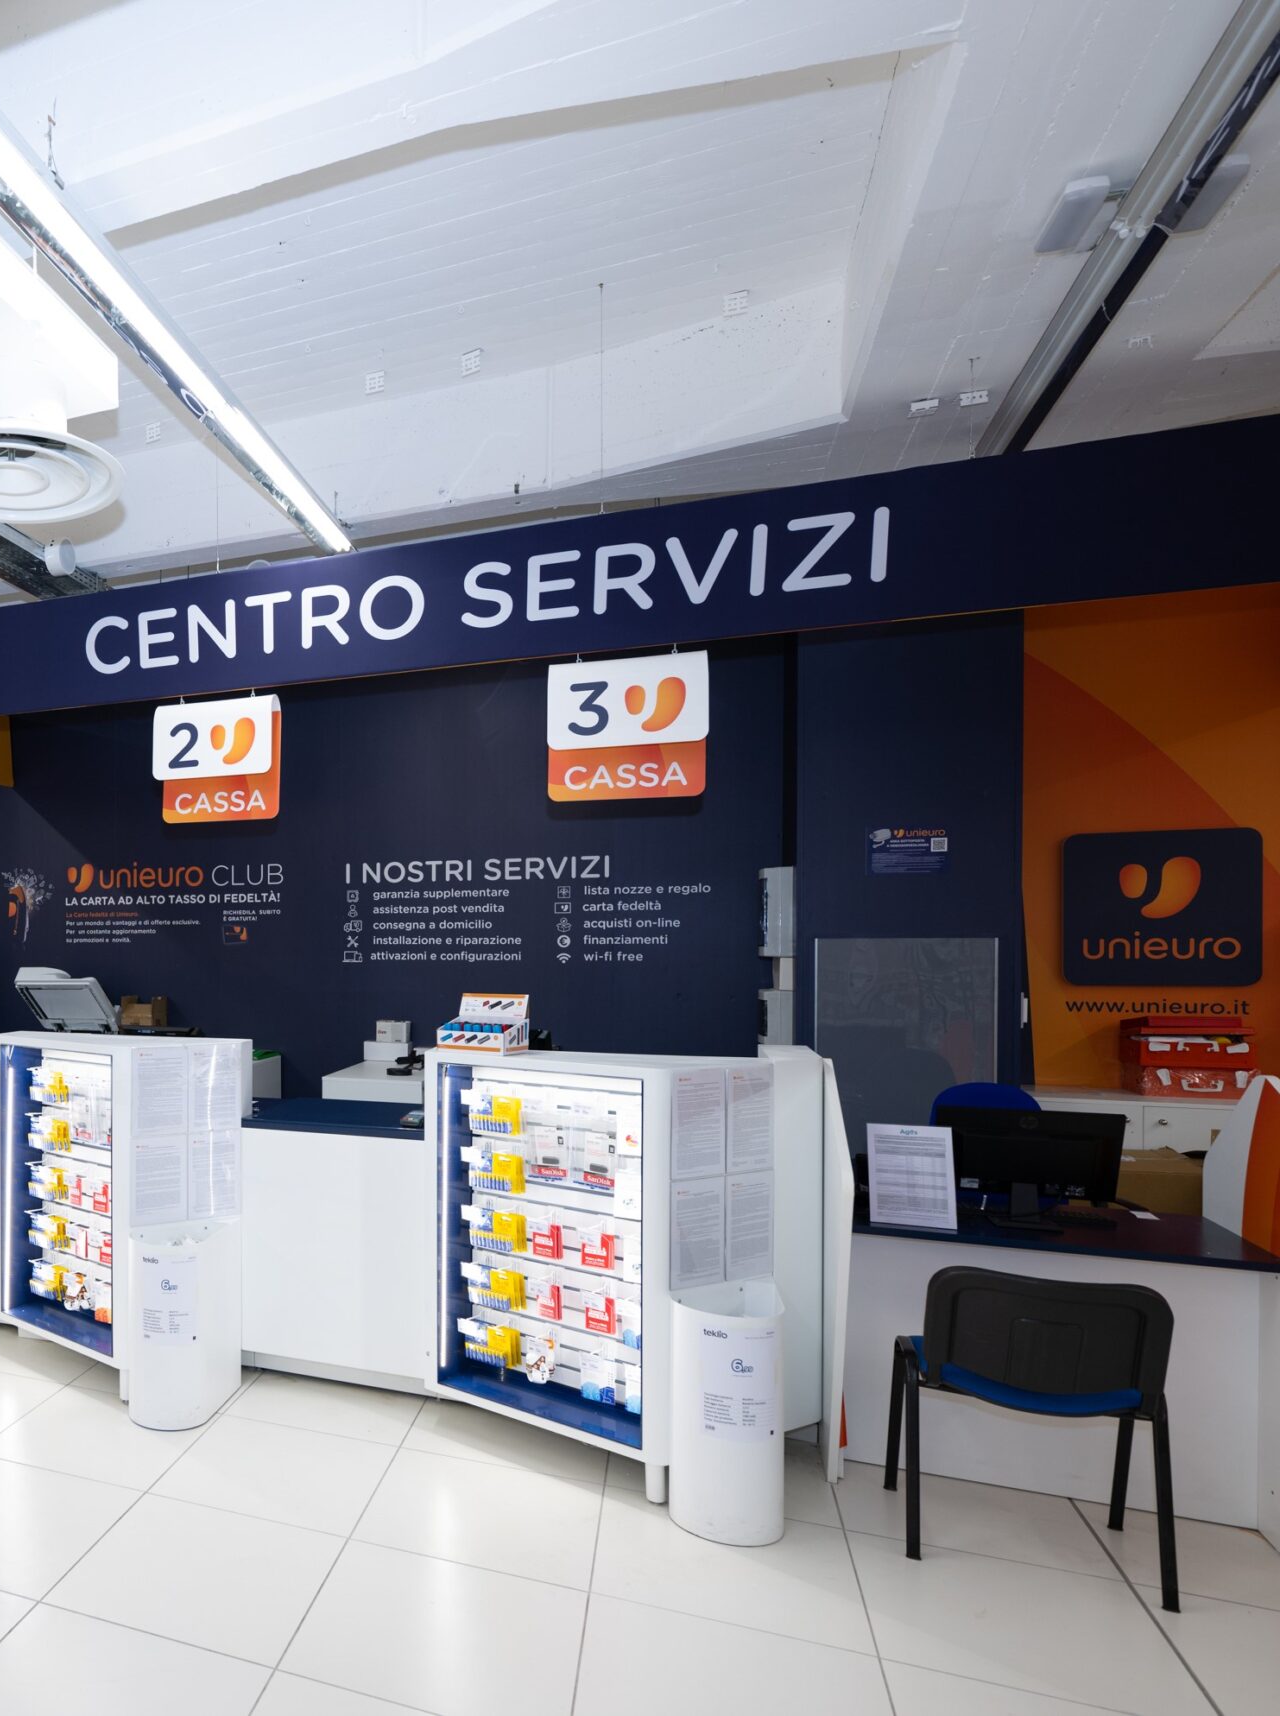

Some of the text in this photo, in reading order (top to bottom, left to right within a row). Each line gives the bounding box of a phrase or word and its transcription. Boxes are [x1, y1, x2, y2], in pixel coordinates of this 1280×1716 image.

[85, 506, 890, 675] CENTRO SERVIZI
[567, 680, 609, 736] 3
[168, 722, 199, 769] 2
[563, 761, 688, 791] CASSA
[174, 789, 266, 815] CASSA
[906, 828, 946, 837] unieuro
[99, 862, 284, 889] unieuro CLUB
[345, 855, 610, 884] I NOSTRI SERVIZI
[372, 888, 510, 900] garanzia supplementare
[584, 885, 610, 895] lista
[614, 886, 652, 894] nozze
[668, 883, 711, 895] regalo
[65, 890, 281, 906] LA CARTA AD ALTO TASSO DI FEDELTÀ!
[372, 903, 505, 915] assistenza post vendita
[582, 900, 662, 911] carta fedeltà
[372, 921, 426, 931] consegna
[439, 919, 493, 929] domicilio
[583, 917, 681, 930] acquisti on-line
[372, 935, 522, 946] installazione e riparazione
[583, 934, 669, 945] finanziamenti
[1081, 930, 1242, 960] unieuro
[370, 951, 522, 962] attivazioni e configurazioni
[583, 951, 644, 962] wi-fi free
[1065, 998, 1251, 1017] www.unieuro.it
[588, 1174, 611, 1185] SanDisk
[703, 1328, 728, 1339] teklio
